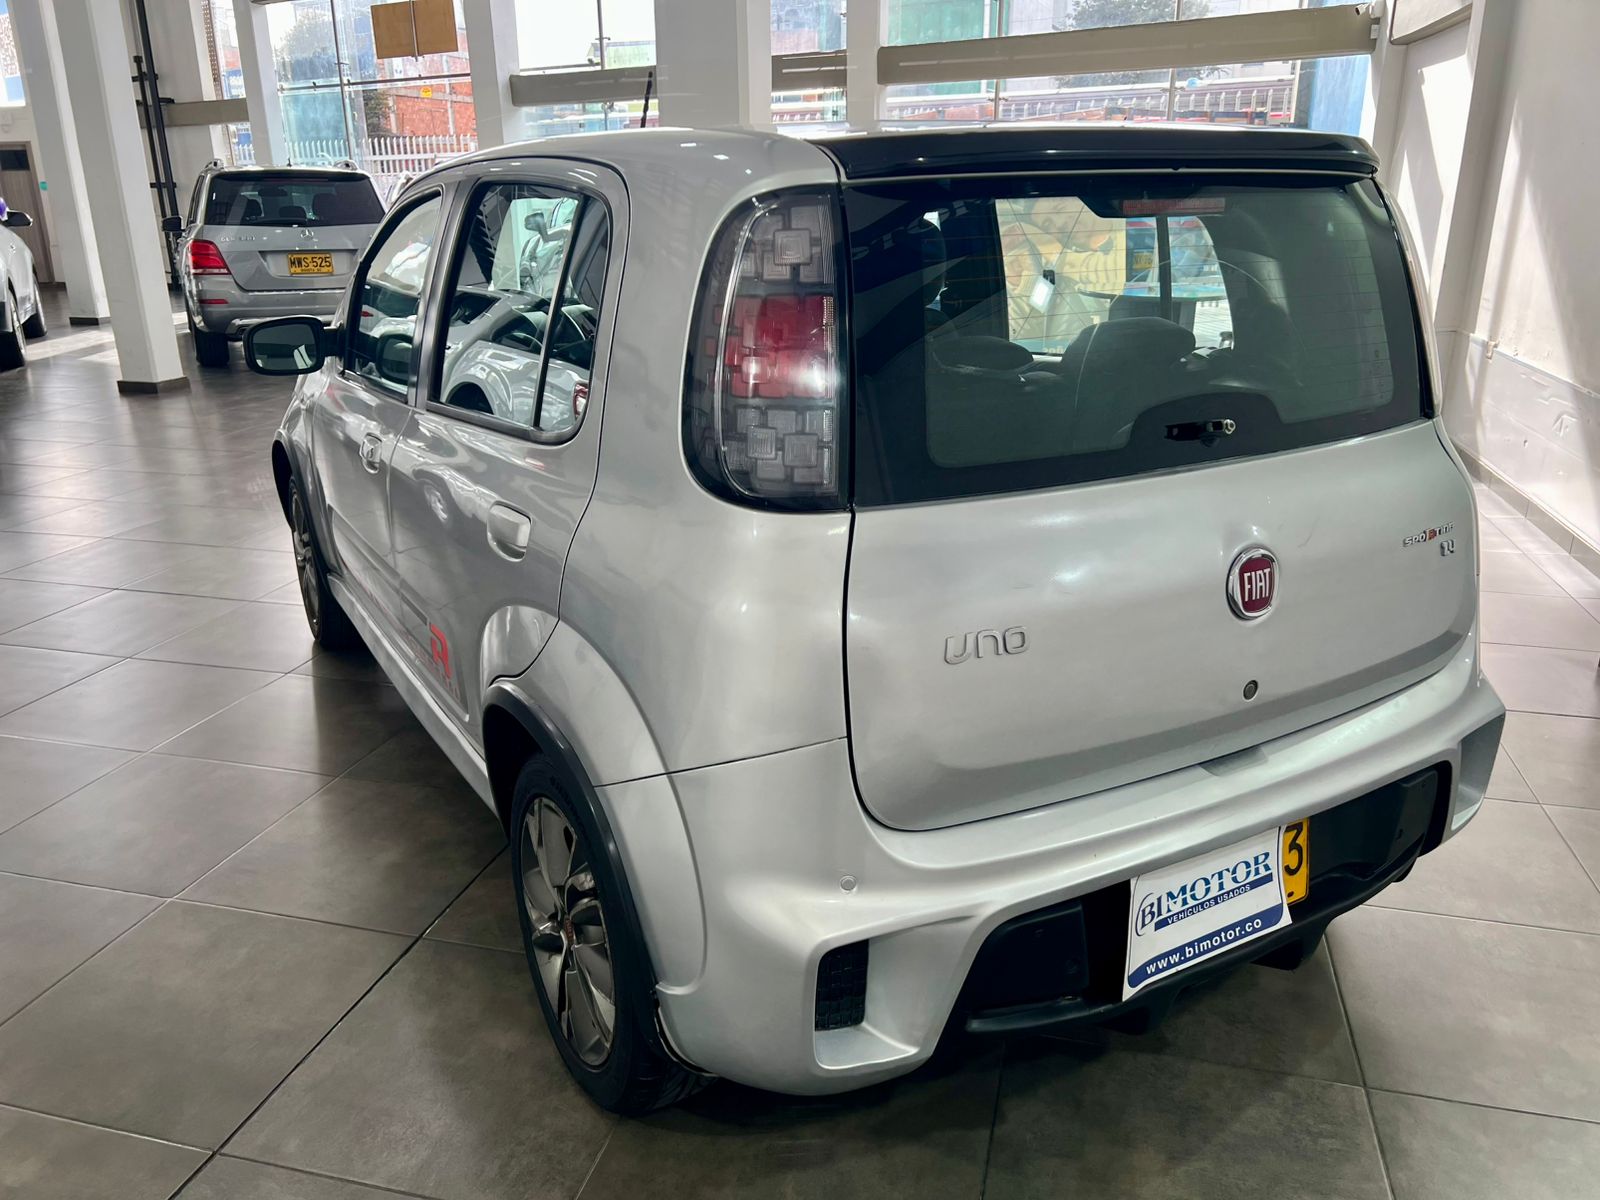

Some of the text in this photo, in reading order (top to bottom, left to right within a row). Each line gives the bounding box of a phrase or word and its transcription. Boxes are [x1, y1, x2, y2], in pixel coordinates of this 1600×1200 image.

[1243, 567, 1272, 602] FIAT
[1140, 851, 1273, 931] BIMOTOR
[1217, 884, 1251, 903] USADOS
[1146, 918, 1262, 975] www.bimotor.co
